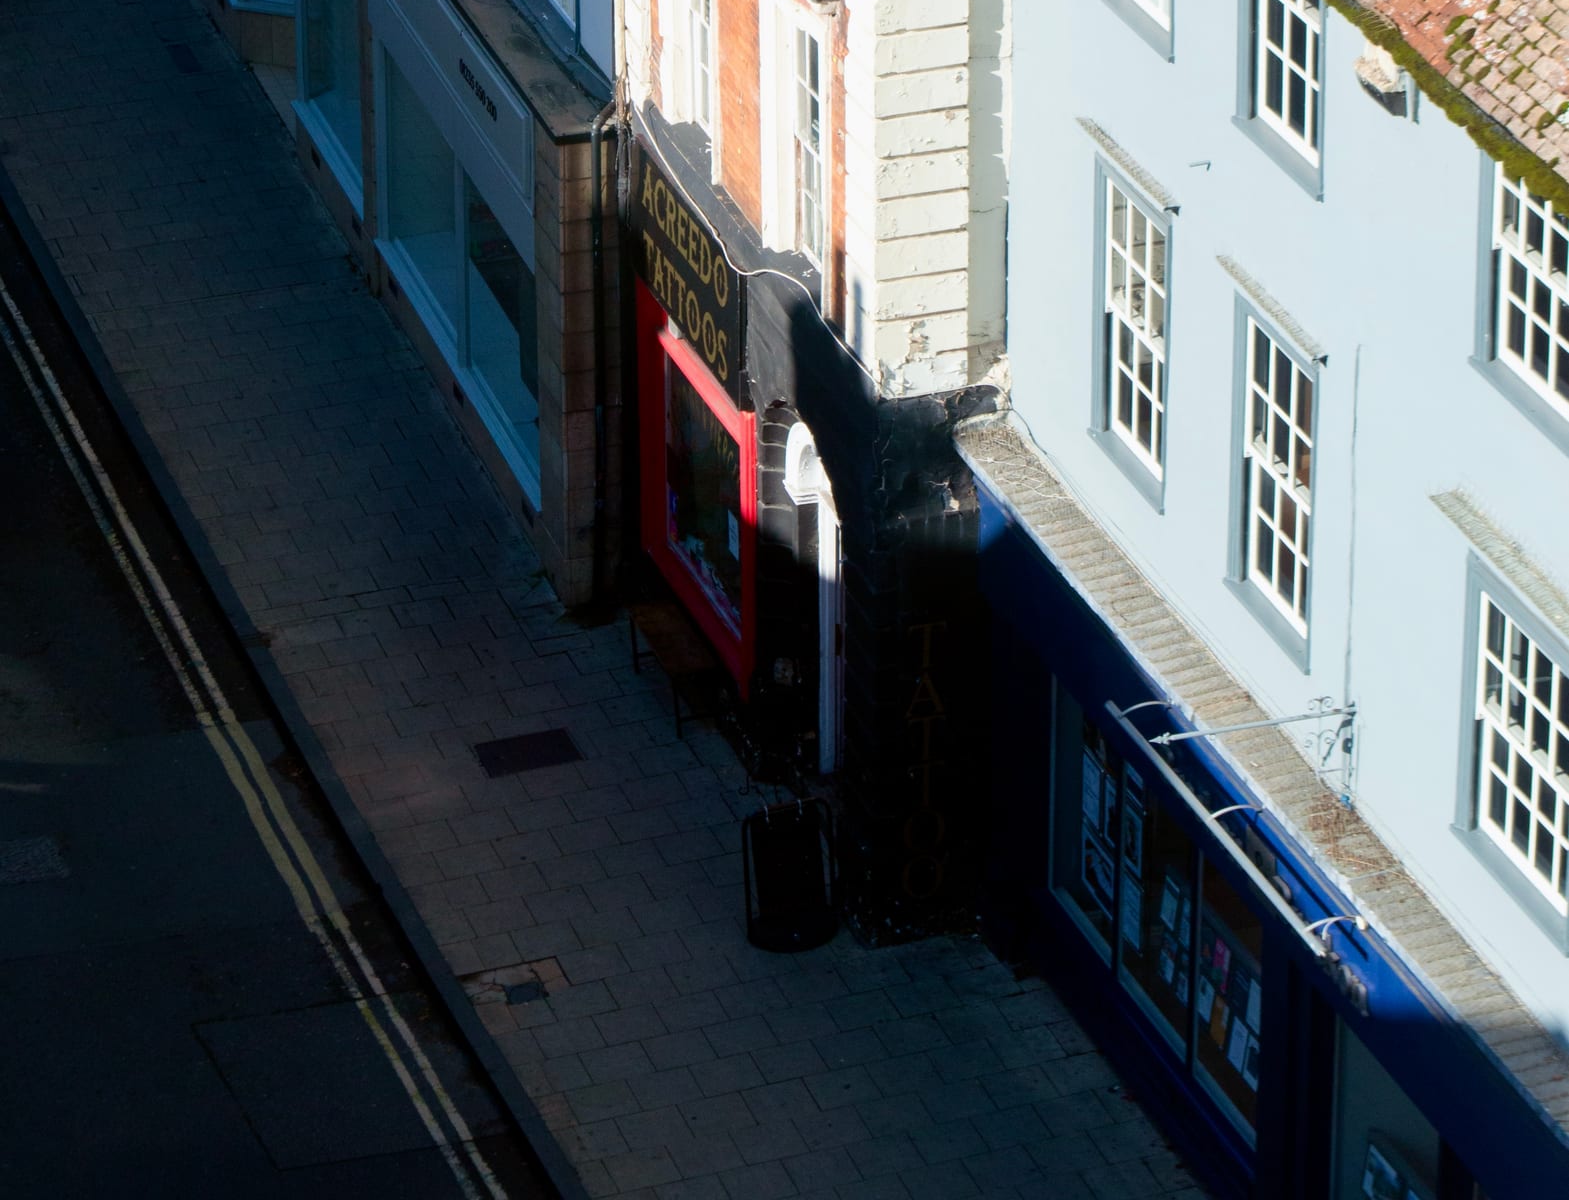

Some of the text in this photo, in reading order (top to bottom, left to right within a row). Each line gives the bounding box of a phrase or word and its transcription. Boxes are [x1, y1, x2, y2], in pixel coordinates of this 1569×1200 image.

[641, 162, 729, 309] ACREEDO
[642, 229, 729, 381] TATTOOS
[903, 617, 949, 900] TATTOO
